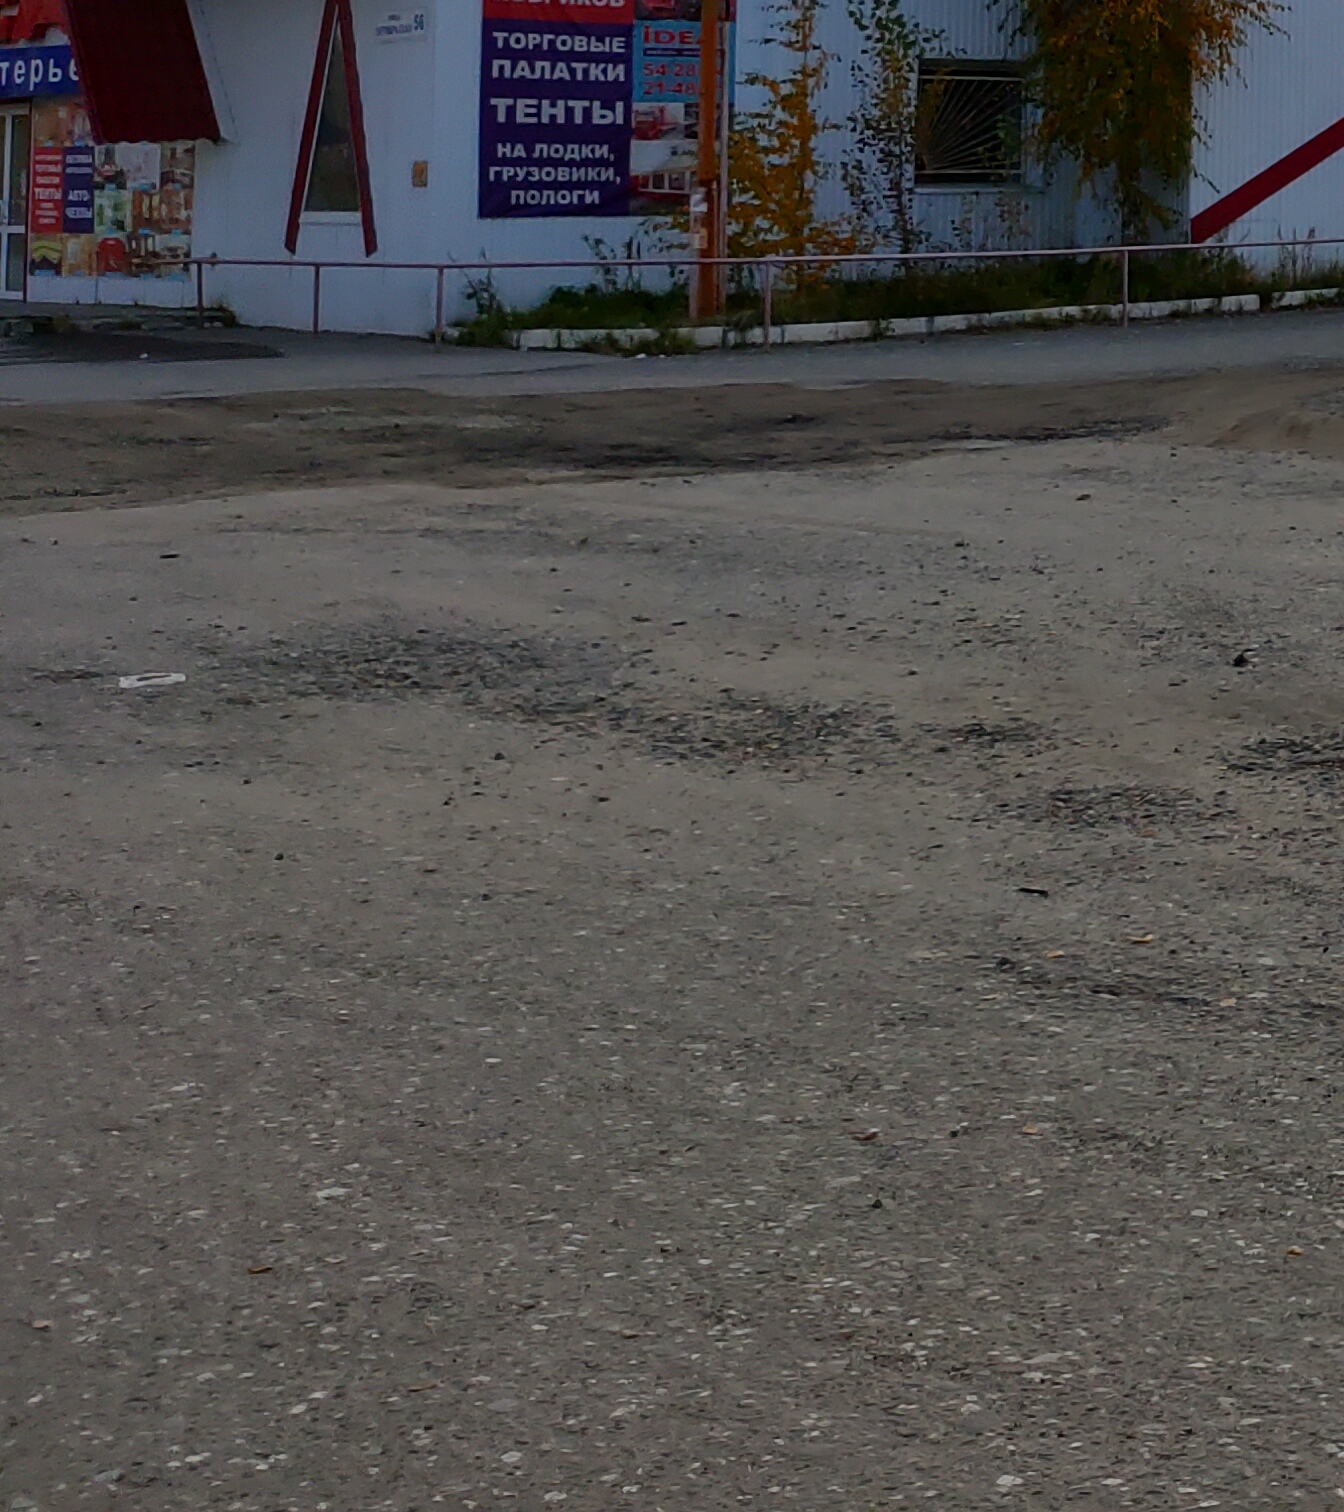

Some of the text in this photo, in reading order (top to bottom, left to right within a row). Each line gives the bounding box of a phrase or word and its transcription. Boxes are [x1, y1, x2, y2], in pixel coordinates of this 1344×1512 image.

[492, 31, 626, 53] ТОРГОВЫЕ
[492, 59, 625, 82] ПАЛАТКИ
[490, 97, 624, 125] ТЕНТЫ
[497, 142, 615, 162] НА ЛОДКИ,
[489, 166, 621, 186] ГРУЗОВИКИ,
[511, 189, 599, 206] ПОЛОГИ
